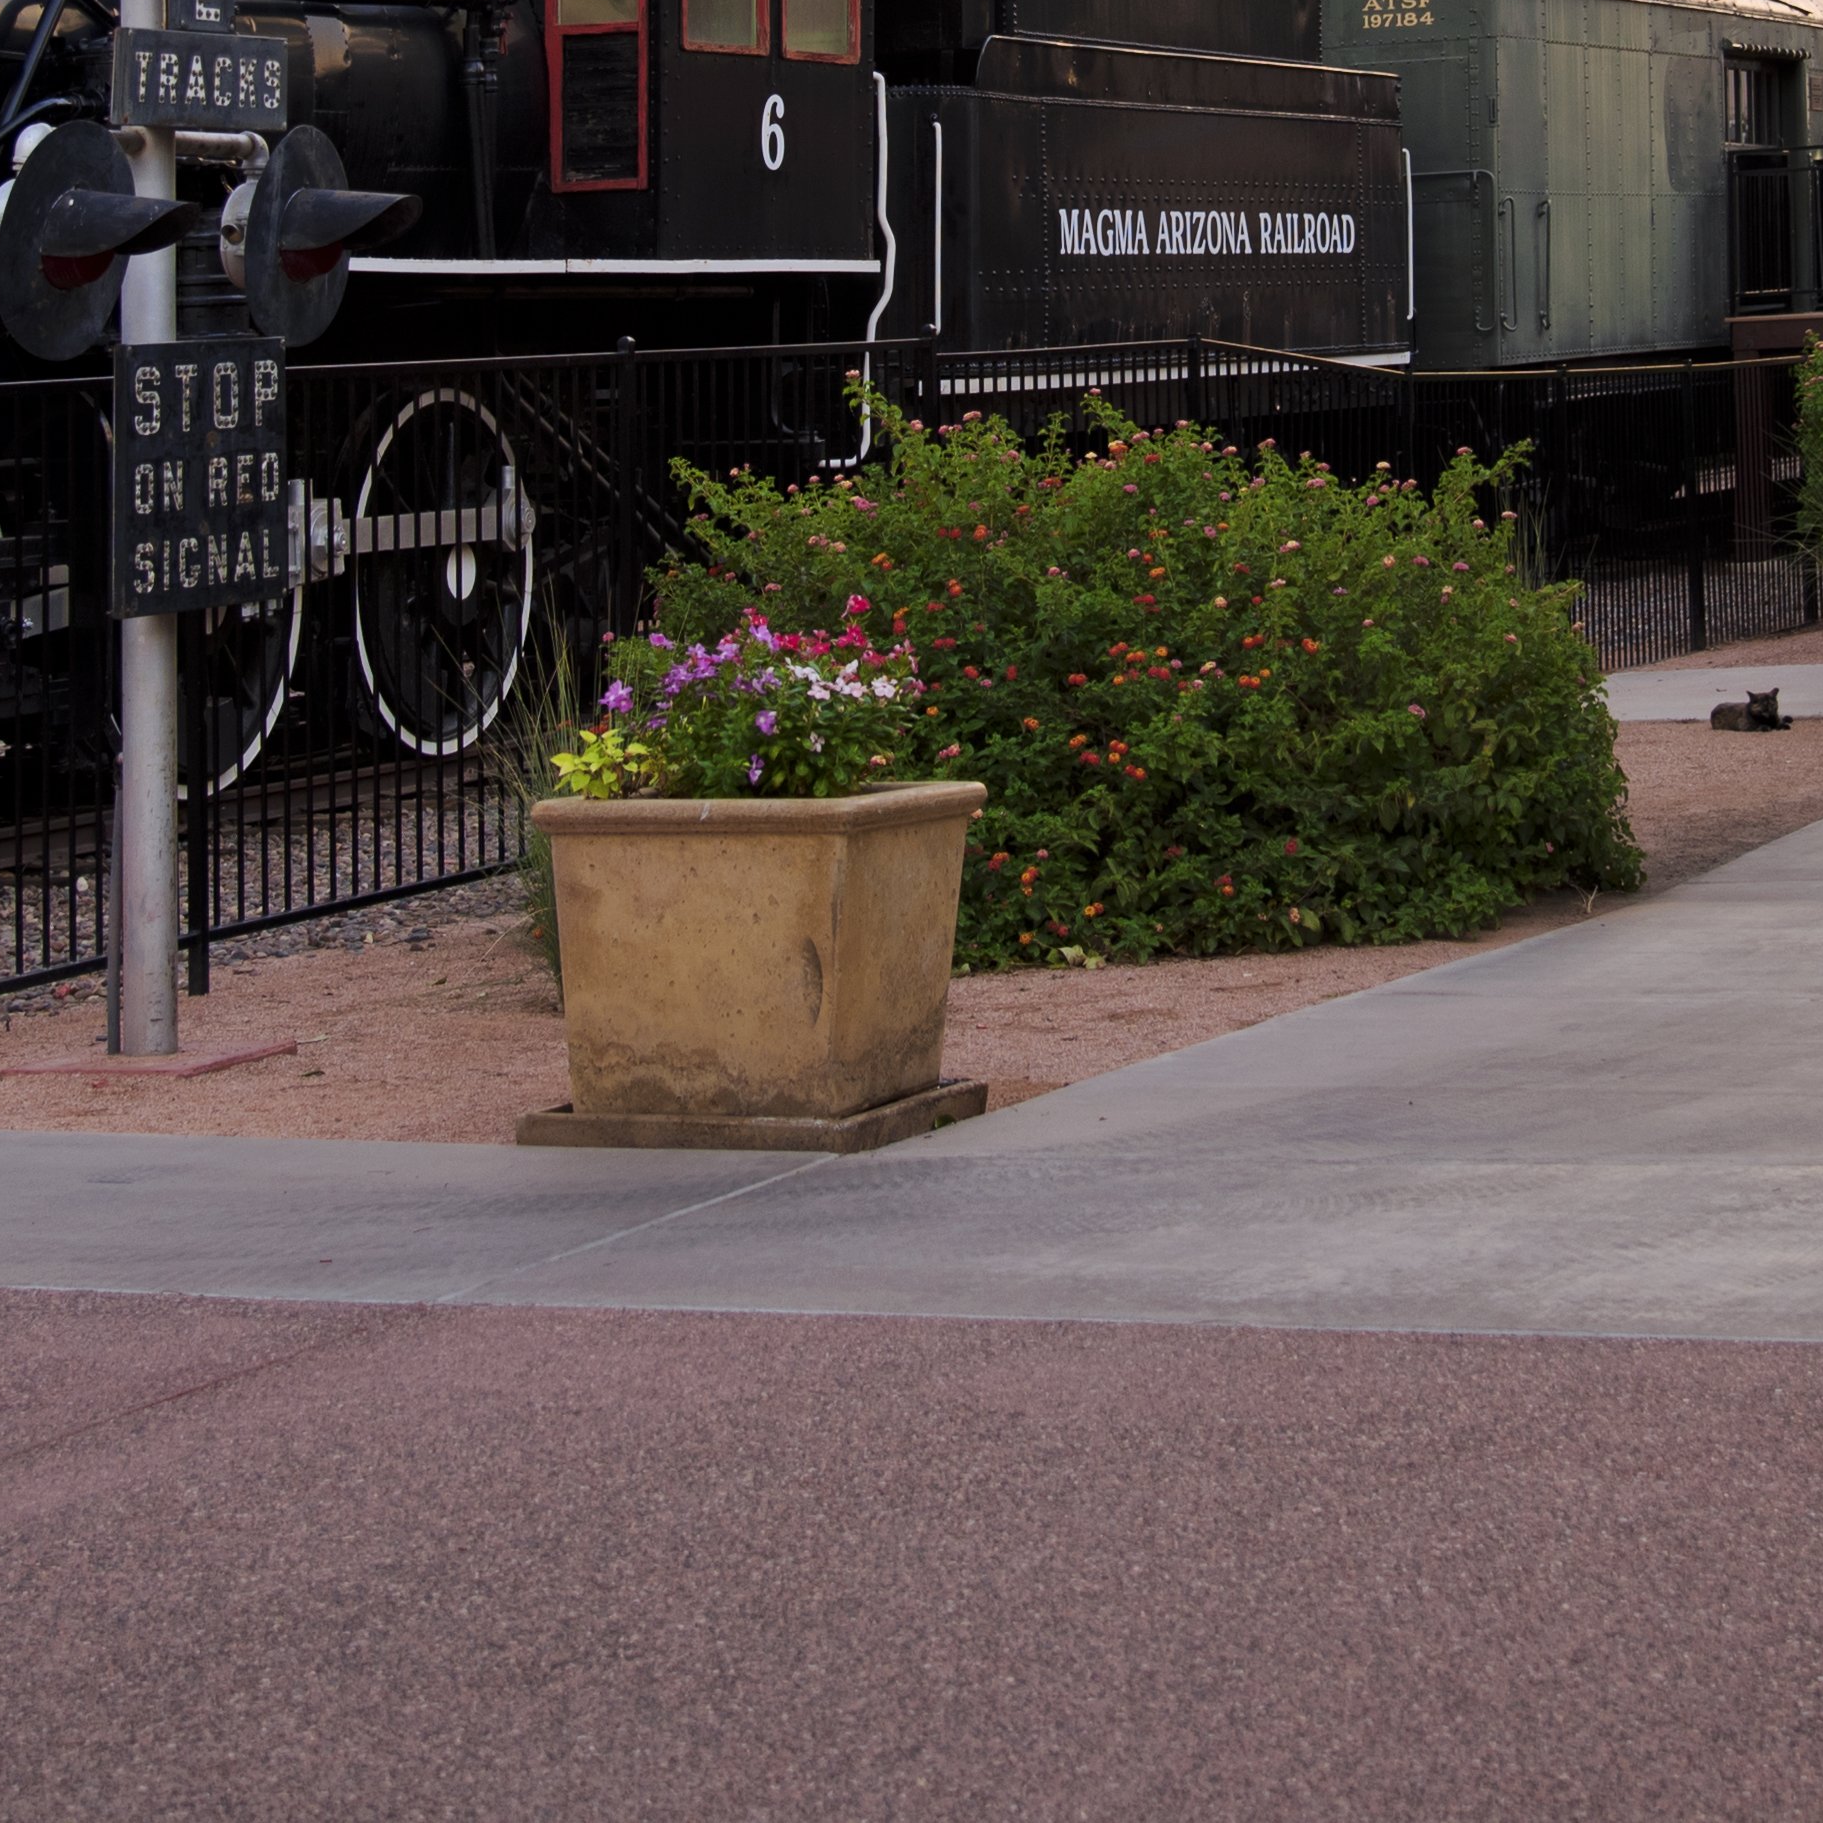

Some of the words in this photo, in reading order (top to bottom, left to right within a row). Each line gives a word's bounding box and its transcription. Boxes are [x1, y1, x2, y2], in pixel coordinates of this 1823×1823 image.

[1363, 11, 1434, 29] 197184
[135, 51, 281, 109] TRACKS
[761, 94, 785, 171] 6
[1059, 209, 1150, 256] MAGMA
[1156, 210, 1253, 255] ARIZONA
[1259, 212, 1356, 254] RAILROAD
[134, 359, 279, 436] STOP
[134, 460, 184, 514] ON
[209, 452, 279, 508] RED
[133, 528, 279, 594] SIGNAL
